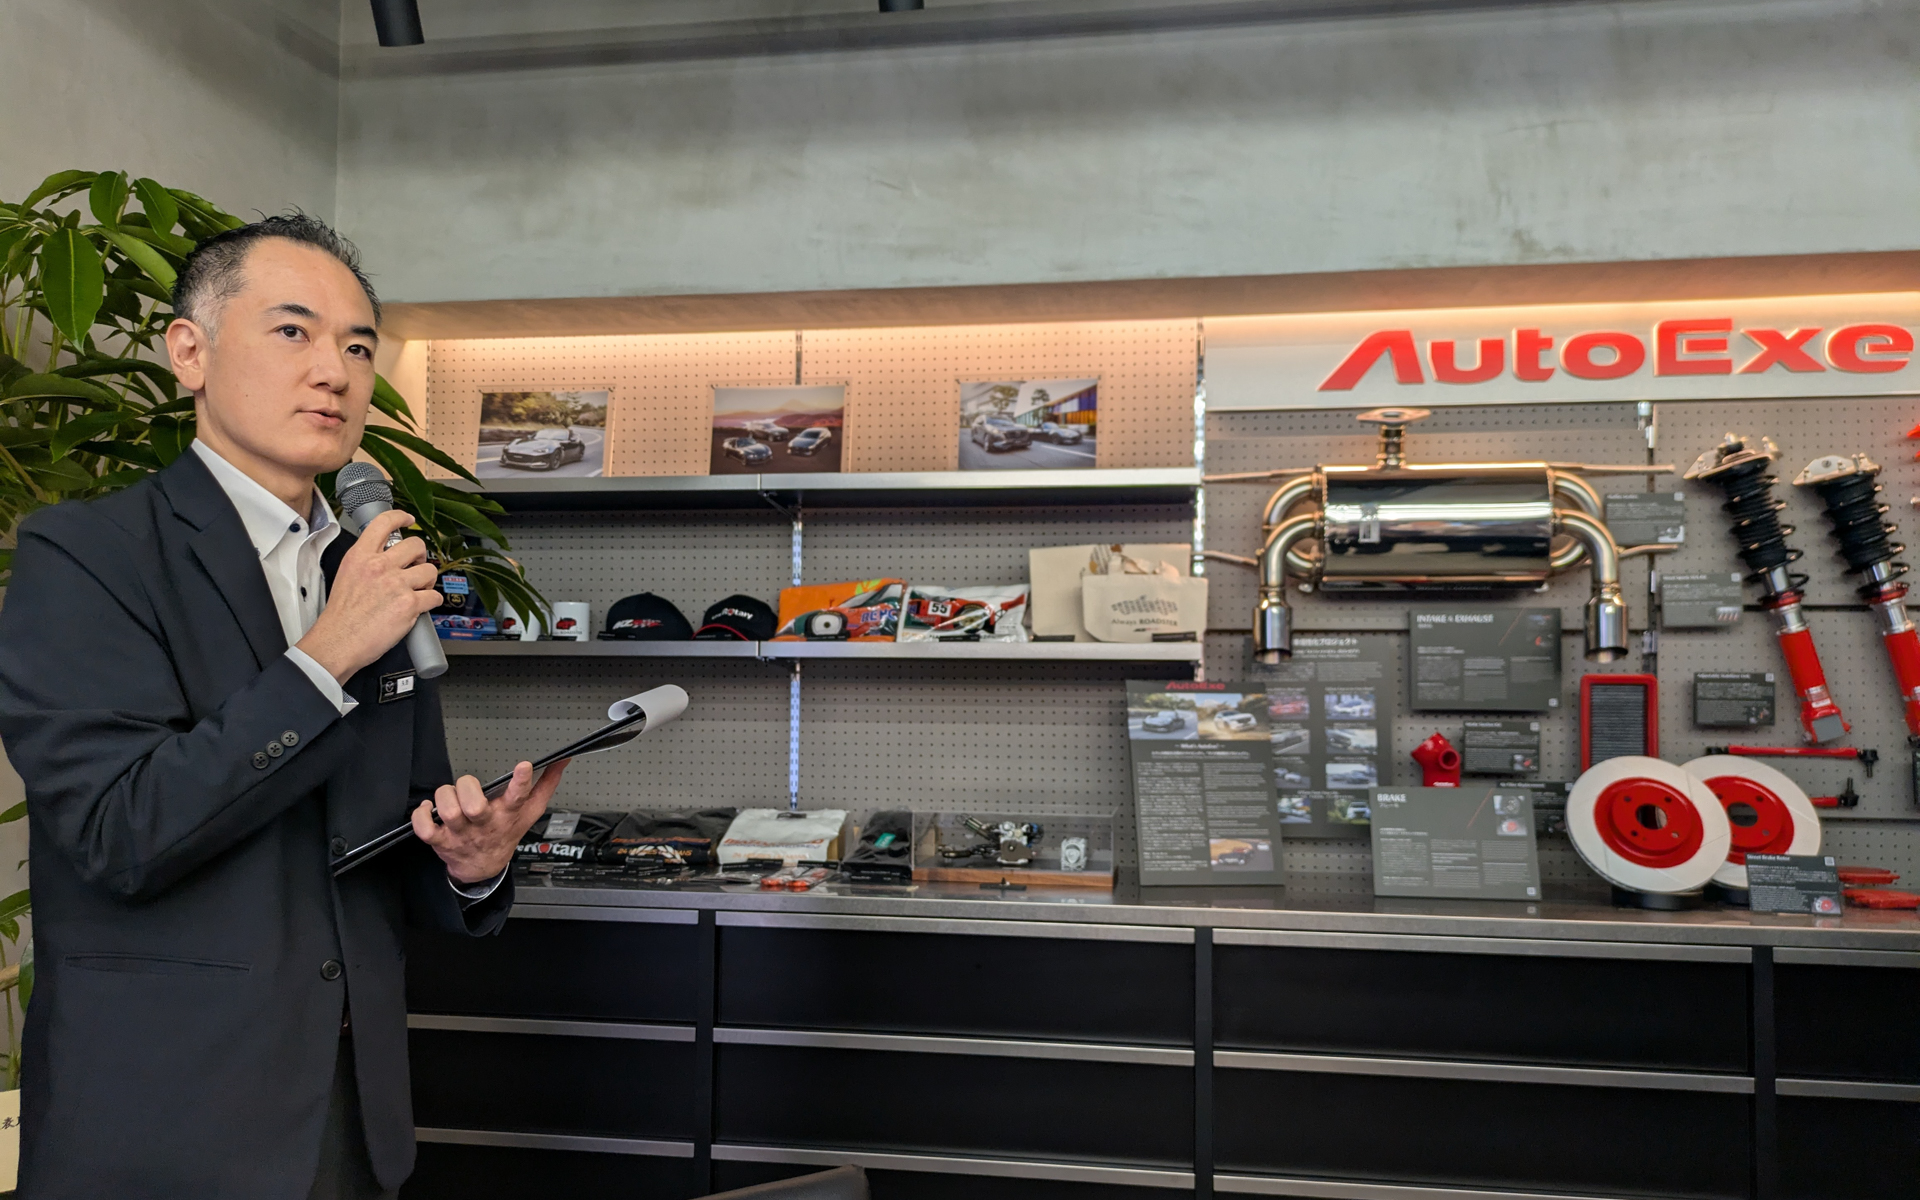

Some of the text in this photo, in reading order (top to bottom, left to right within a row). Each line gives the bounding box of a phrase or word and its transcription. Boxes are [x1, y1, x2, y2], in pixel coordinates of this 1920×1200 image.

[1318, 318, 1914, 391] AutoExe
[931, 602, 948, 614] 55
[1111, 618, 1178, 627] Always ROADSTER
[1416, 614, 1446, 623] INTAKE
[1455, 613, 1494, 623] EXHAUST
[1165, 681, 1226, 690] AutoExe
[1377, 793, 1407, 803] BRAKE
